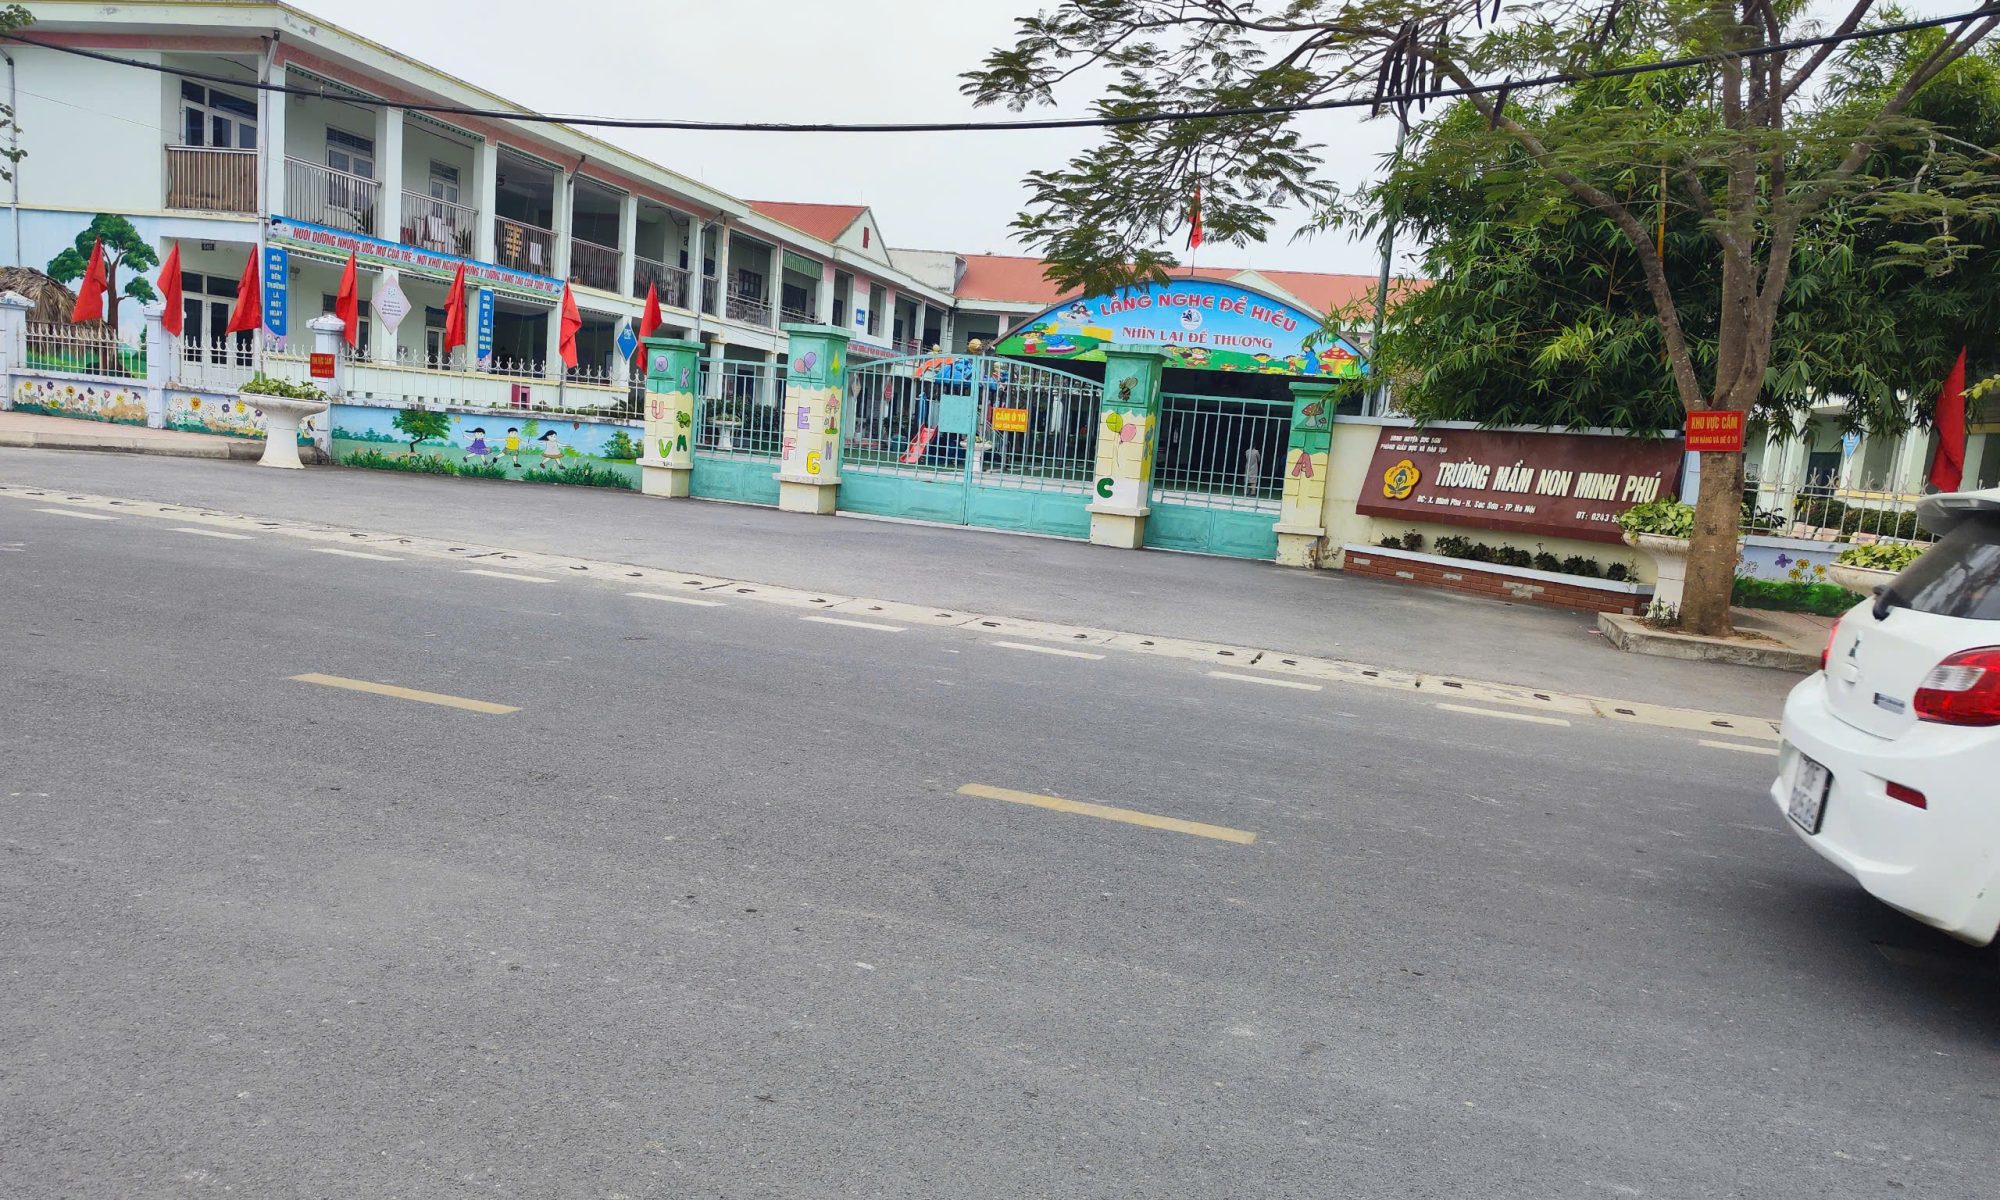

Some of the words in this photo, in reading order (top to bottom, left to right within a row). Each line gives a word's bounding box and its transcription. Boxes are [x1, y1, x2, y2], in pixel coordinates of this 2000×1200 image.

[1158, 293, 1215, 309] NGHE
[1219, 296, 1248, 315] ĐỂ
[1251, 304, 1297, 333] HIỂU
[1122, 326, 1155, 340] NHÌN
[1160, 330, 1183, 346] LẠI
[1213, 333, 1273, 349] THƯƠNG
[680, 367, 691, 388] K
[652, 400, 665, 419] U
[797, 406, 810, 429] E
[1691, 416, 1704, 429] KHU
[1706, 416, 1720, 431] VỰC
[1722, 414, 1738, 429] CẤM
[658, 439, 672, 458] V
[782, 437, 796, 460] F
[806, 451, 820, 474] G
[1291, 452, 1314, 478] A
[1096, 477, 1114, 498] C
[1435, 457, 1490, 490] TRƯỜNG
[1492, 459, 1534, 493] MẦM
[1535, 468, 1573, 497] NON
[1573, 472, 1621, 501] MINH
[1621, 471, 1661, 503] PHÚ
[1591, 512, 1610, 522] 0243
